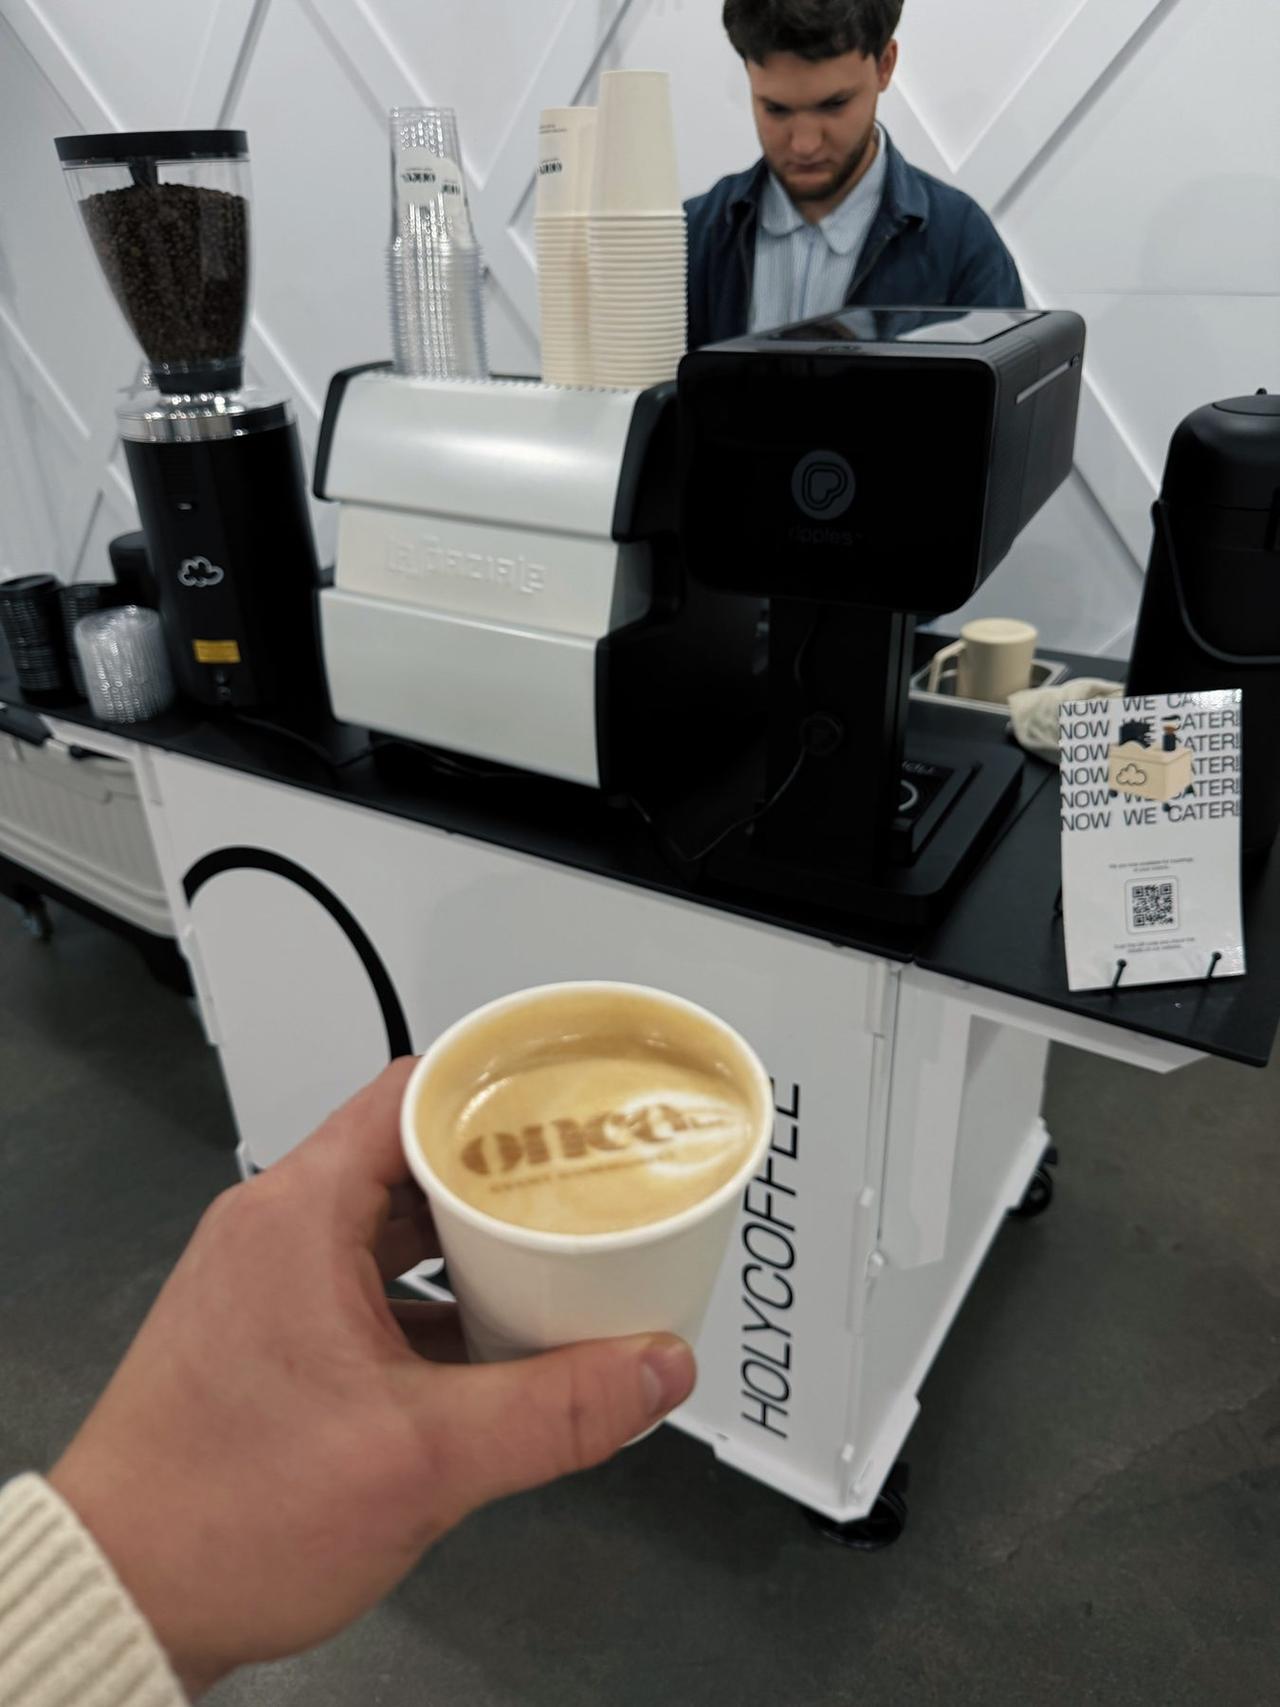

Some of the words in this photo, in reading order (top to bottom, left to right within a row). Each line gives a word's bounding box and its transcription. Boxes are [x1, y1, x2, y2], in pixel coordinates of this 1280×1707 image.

[1122, 695, 1157, 712] WE
[1059, 720, 1111, 740] NOW
[1060, 743, 1111, 764] NOW
[1060, 766, 1110, 787] NOW
[1060, 789, 1111, 811] NOW
[1061, 811, 1112, 832] NOW
[1123, 807, 1157, 826] WE
